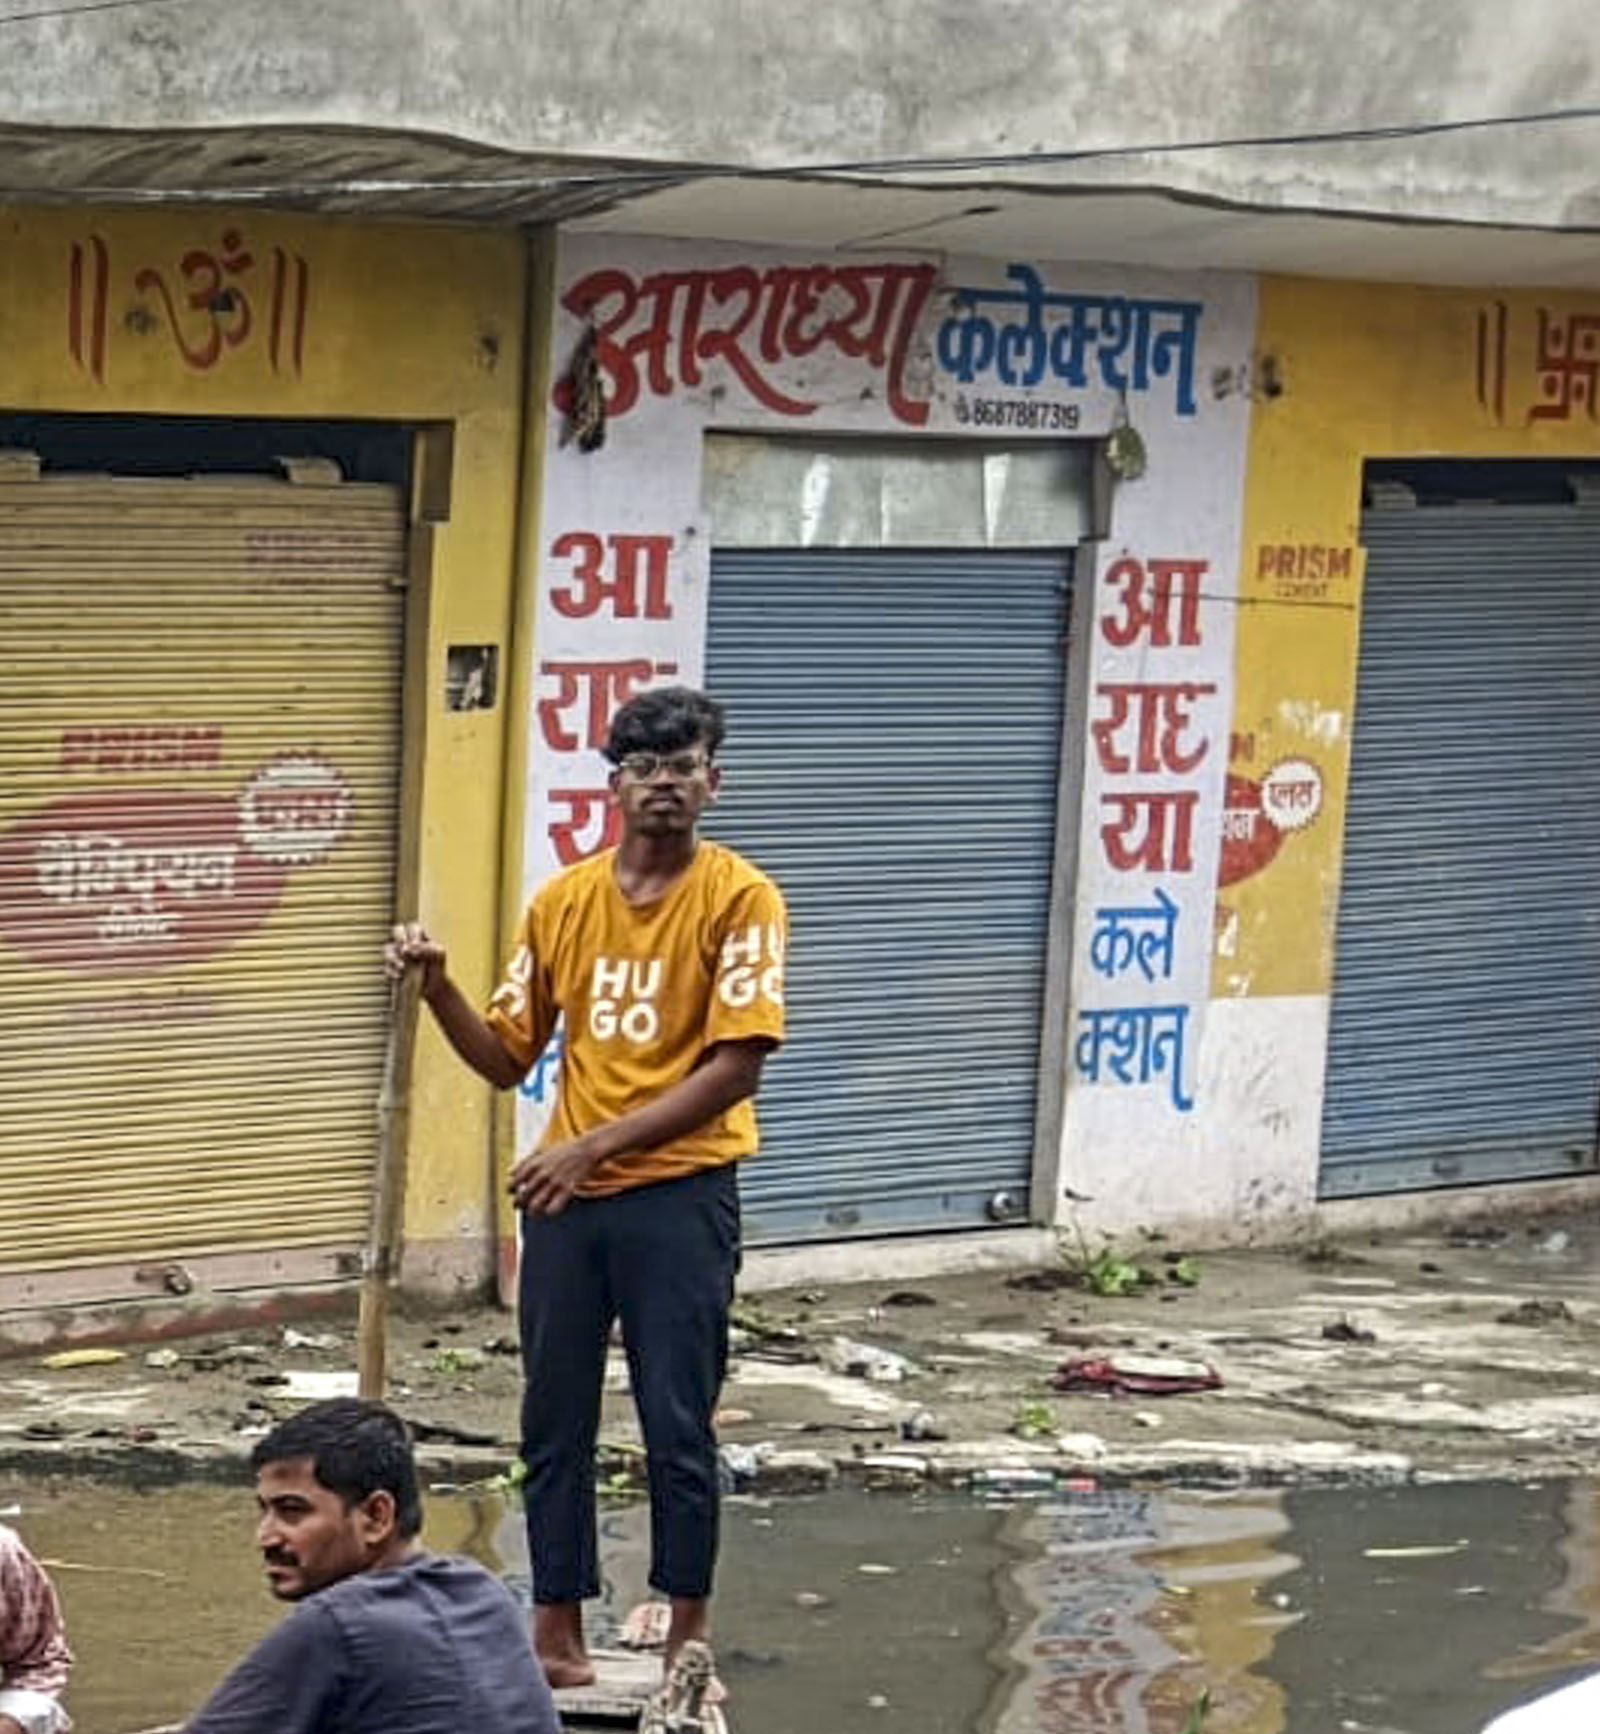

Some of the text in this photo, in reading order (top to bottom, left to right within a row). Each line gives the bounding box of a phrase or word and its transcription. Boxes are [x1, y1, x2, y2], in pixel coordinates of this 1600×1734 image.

[553, 262, 1203, 427] आराध्या कलेक्शन
[550, 531, 674, 620] आ
[1102, 557, 1209, 647] आ
[1257, 544, 1353, 583] PRISM
[1101, 791, 1200, 873] या
[591, 956, 663, 999] HU
[1091, 886, 1179, 984] कले
[589, 999, 659, 1042] GO
